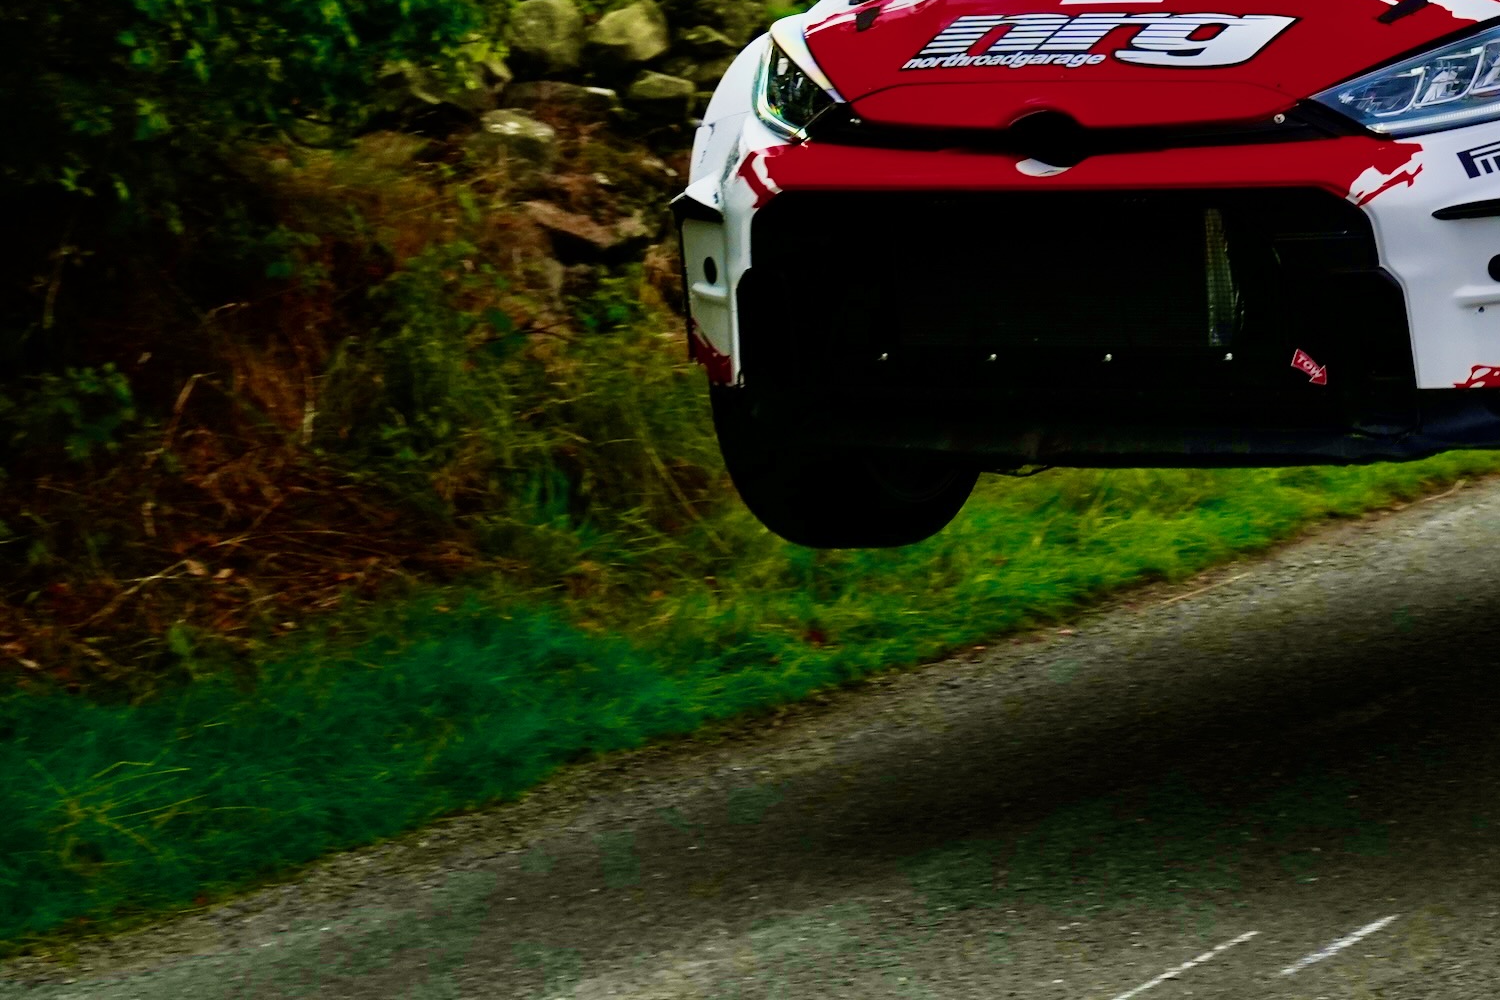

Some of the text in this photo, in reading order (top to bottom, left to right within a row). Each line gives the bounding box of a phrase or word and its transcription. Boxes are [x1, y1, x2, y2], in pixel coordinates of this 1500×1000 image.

[917, 12, 1298, 69] nrg
[901, 50, 1107, 70] northroadgarage
[1297, 354, 1323, 378] TOW
